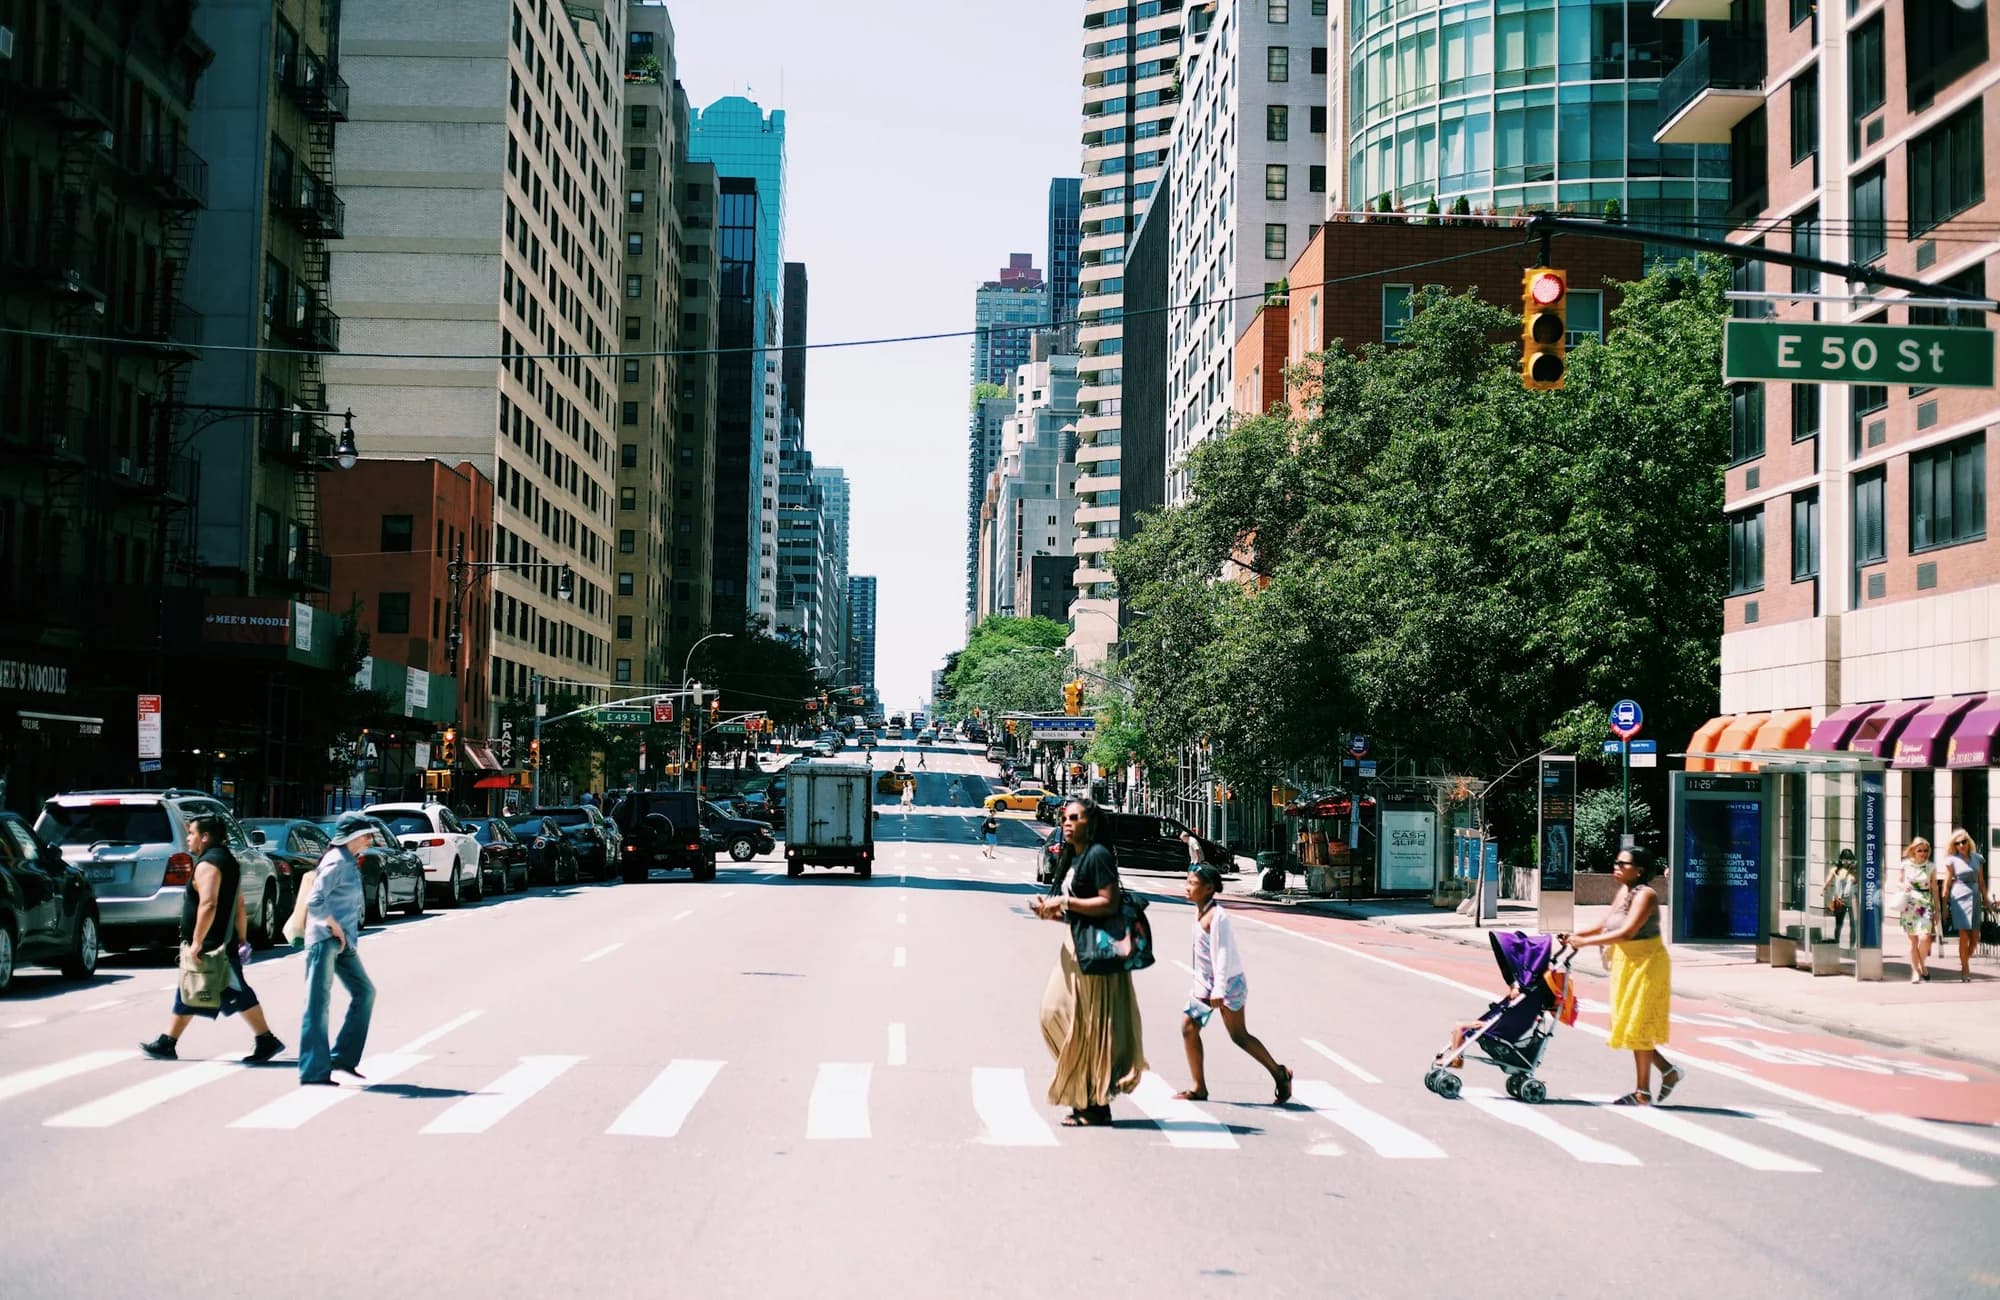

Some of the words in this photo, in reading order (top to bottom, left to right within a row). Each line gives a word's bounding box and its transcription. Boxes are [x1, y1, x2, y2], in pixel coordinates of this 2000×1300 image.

[1777, 335, 1802, 368] E
[1820, 336, 1878, 371] 50
[1896, 339, 1945, 373] St
[215, 615, 247, 625] MEE'S
[27, 663, 67, 695] NOODLE
[607, 713, 613, 721] E
[615, 713, 628, 721] 49
[630, 713, 641, 721] St
[1866, 795, 1876, 832] Avenue
[1392, 831, 1426, 839] CASH
[1866, 833, 1876, 841] &
[1866, 843, 1876, 865] East
[1866, 867, 1876, 880] 50
[1866, 882, 1876, 911] Street
